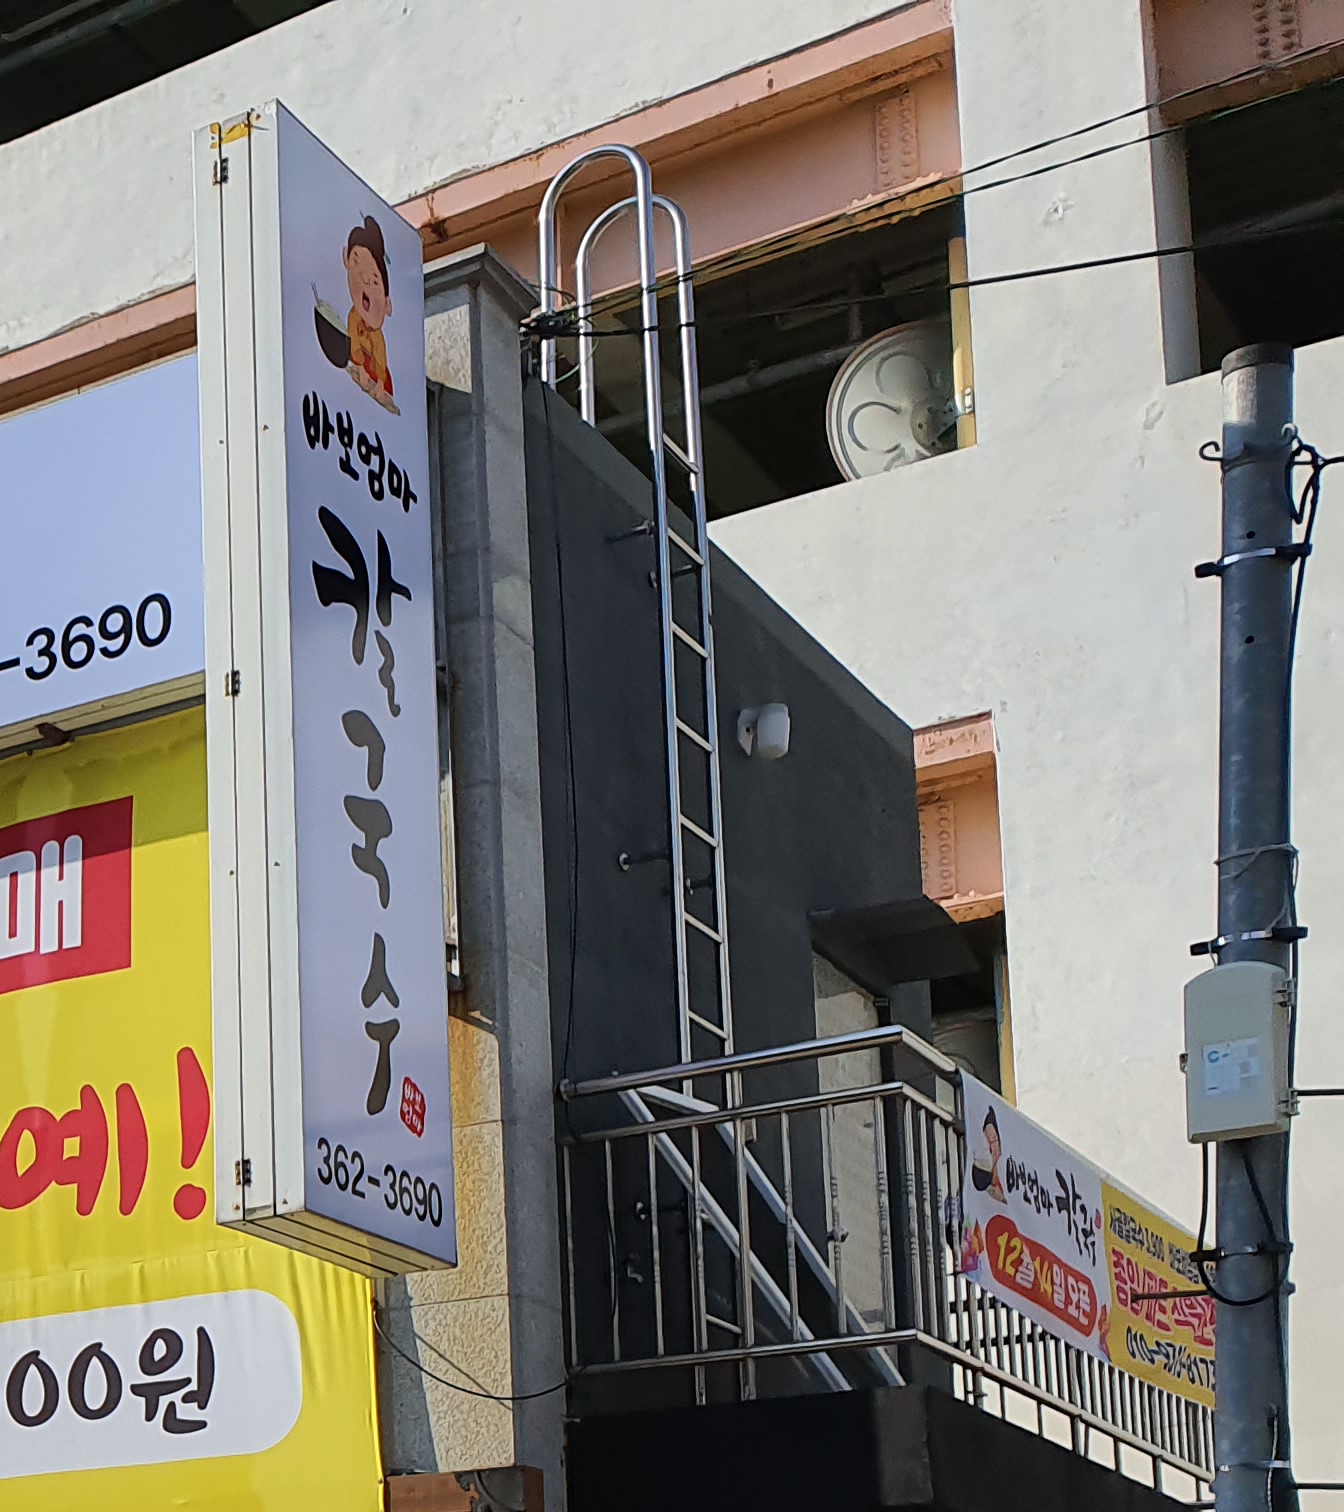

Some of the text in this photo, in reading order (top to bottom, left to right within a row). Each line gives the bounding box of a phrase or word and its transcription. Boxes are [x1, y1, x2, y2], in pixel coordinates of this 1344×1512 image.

[302, 390, 417, 513] 바보엄마
[312, 505, 412, 1115] 칼국수
[316, 1136, 443, 1228] 362-3690
[1005, 1154, 1054, 1218] 바보엄마
[1066, 1274, 1092, 1326] 오픈
